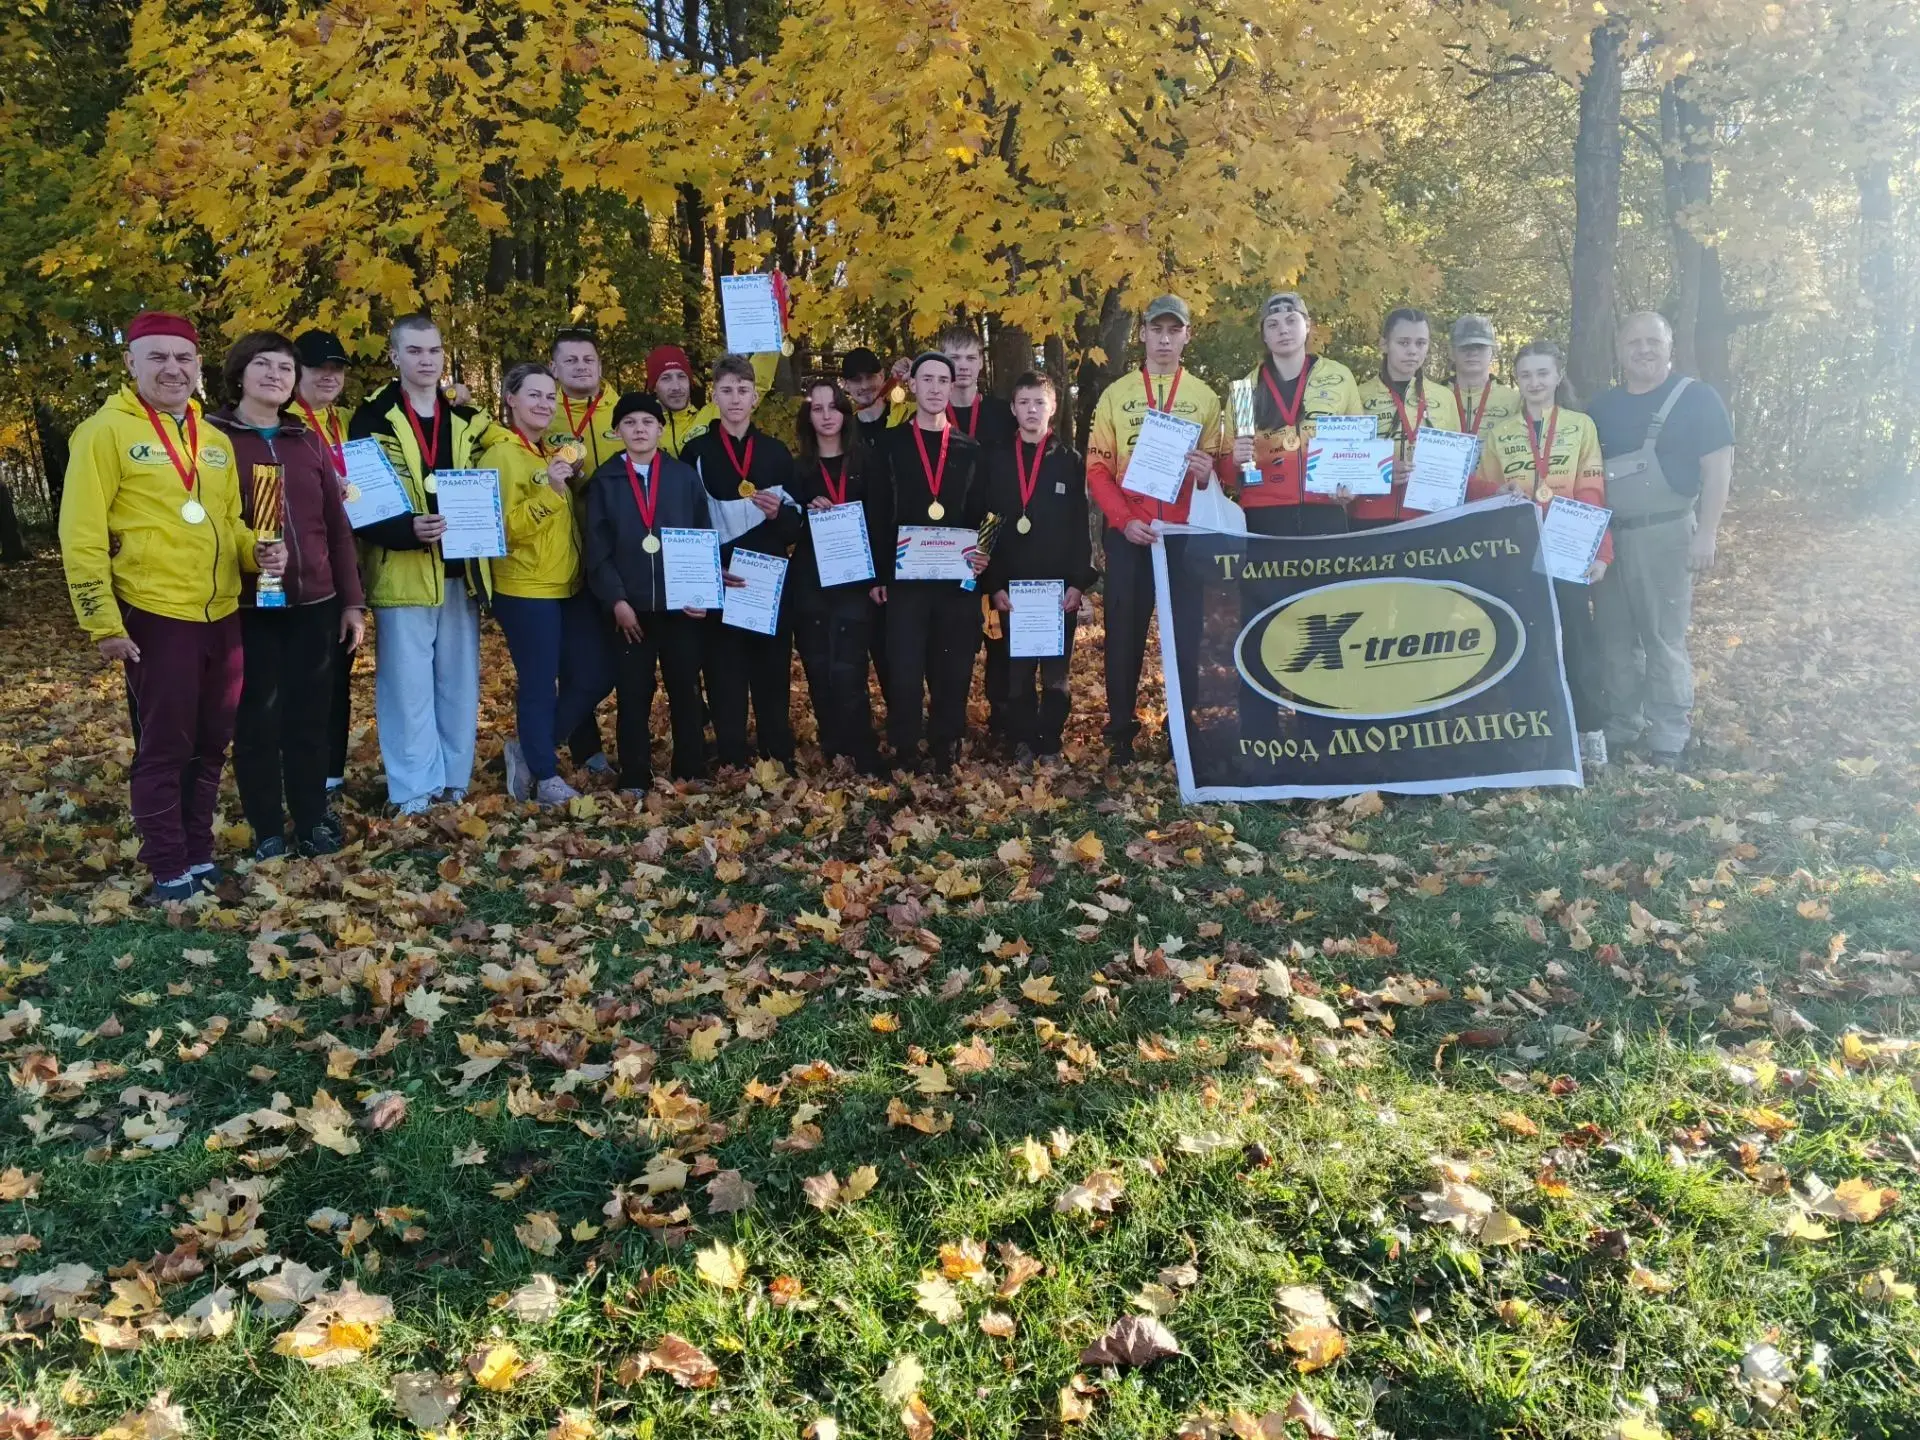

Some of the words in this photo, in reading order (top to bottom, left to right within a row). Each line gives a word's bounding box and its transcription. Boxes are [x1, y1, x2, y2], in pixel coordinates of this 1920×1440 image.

[1146, 418, 1181, 434] ГРАМОТА
[1419, 436, 1456, 448] ГРАМОТА
[1332, 452, 1371, 460] ДИПЛОМ
[438, 479, 479, 487] ГРАМОТА
[1551, 503, 1590, 520] ГРАМОТА
[810, 513, 847, 524] ГРАМОТА
[663, 537, 701, 545] ГРАМОТА
[920, 539, 956, 547] ДИПЛОМ
[732, 556, 769, 570] ГРАМОТА
[1274, 611, 1481, 673] X-treme
[1239, 738, 1320, 765] город
[1328, 709, 1554, 756] МОРШАНСК
